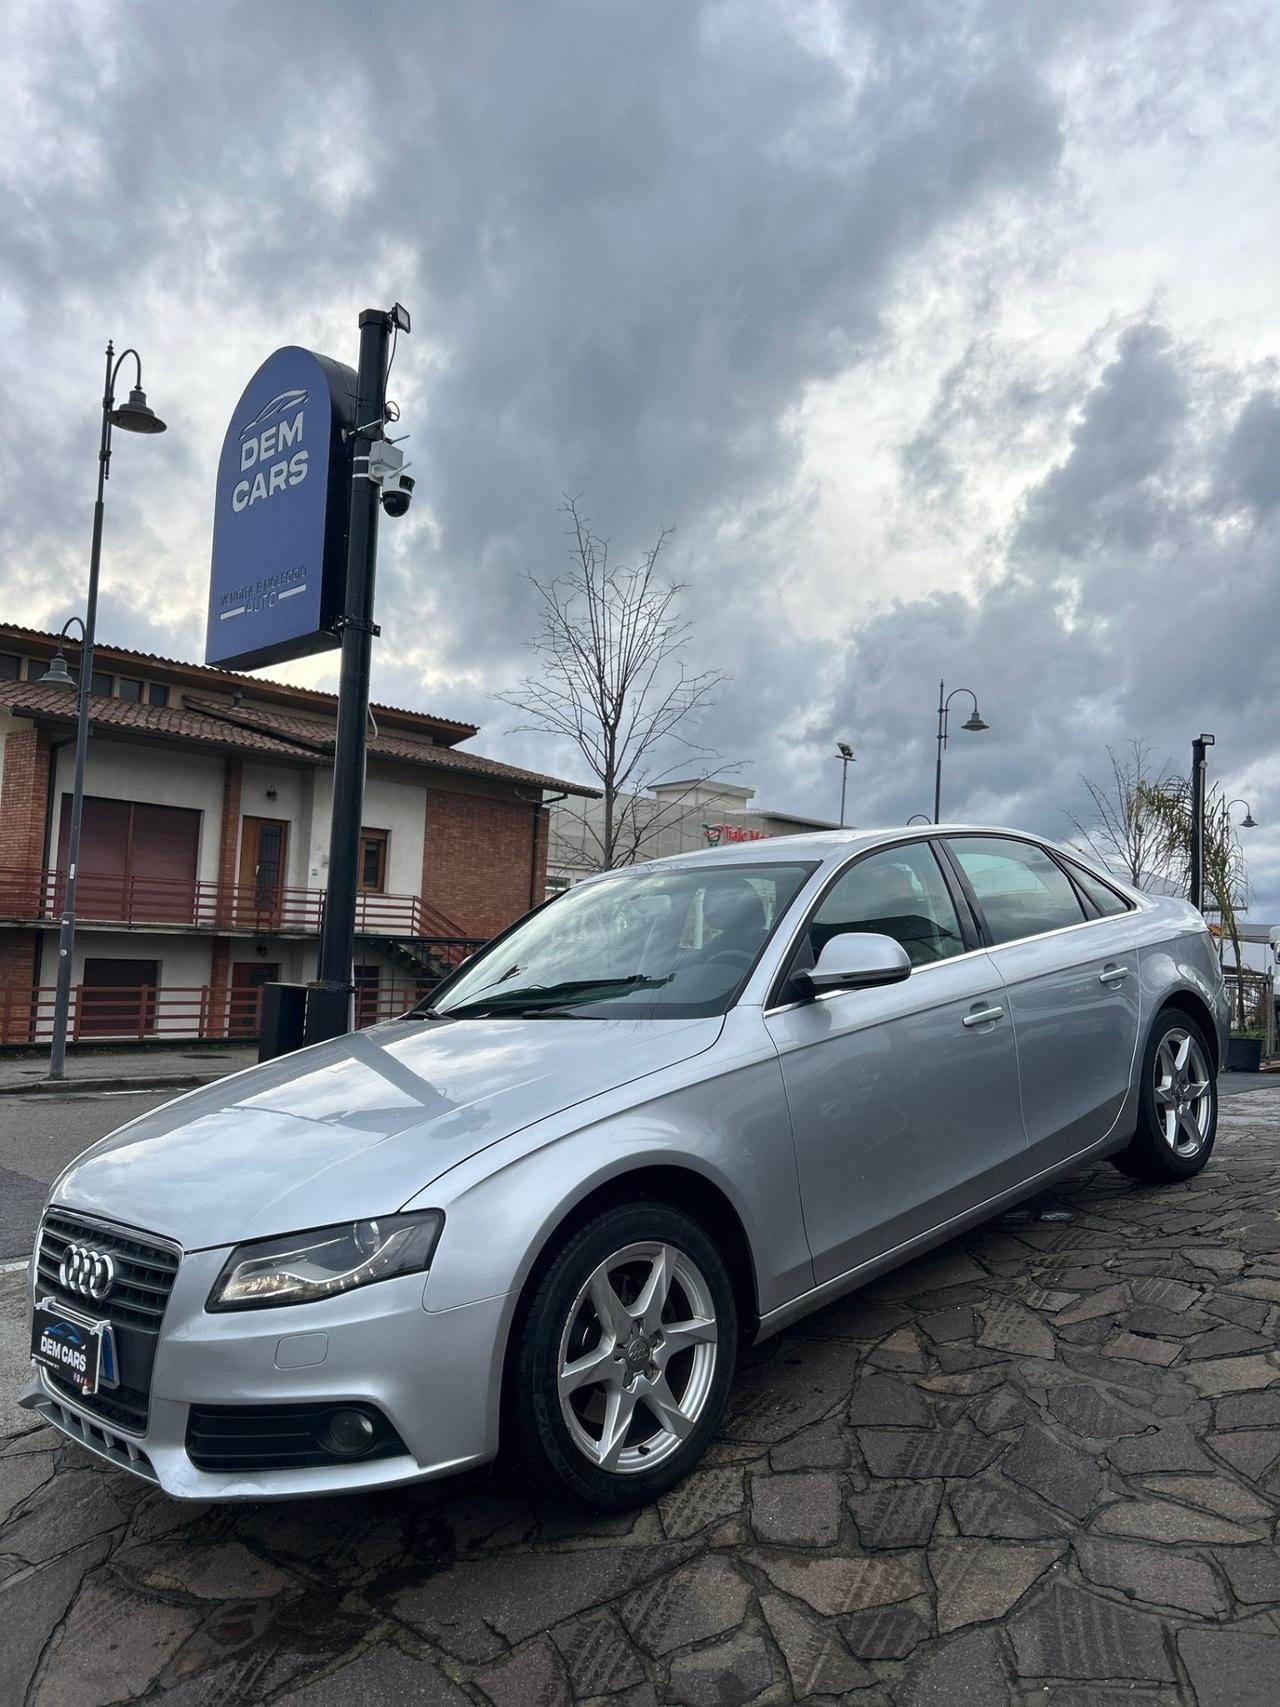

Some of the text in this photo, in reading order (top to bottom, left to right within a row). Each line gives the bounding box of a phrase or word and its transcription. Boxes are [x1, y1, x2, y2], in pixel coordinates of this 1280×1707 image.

[240, 411, 304, 472] DEM
[232, 450, 309, 513] CARS
[245, 591, 276, 616] AUTO
[41, 1336, 61, 1359] DEM
[62, 1346, 86, 1372] CARS
